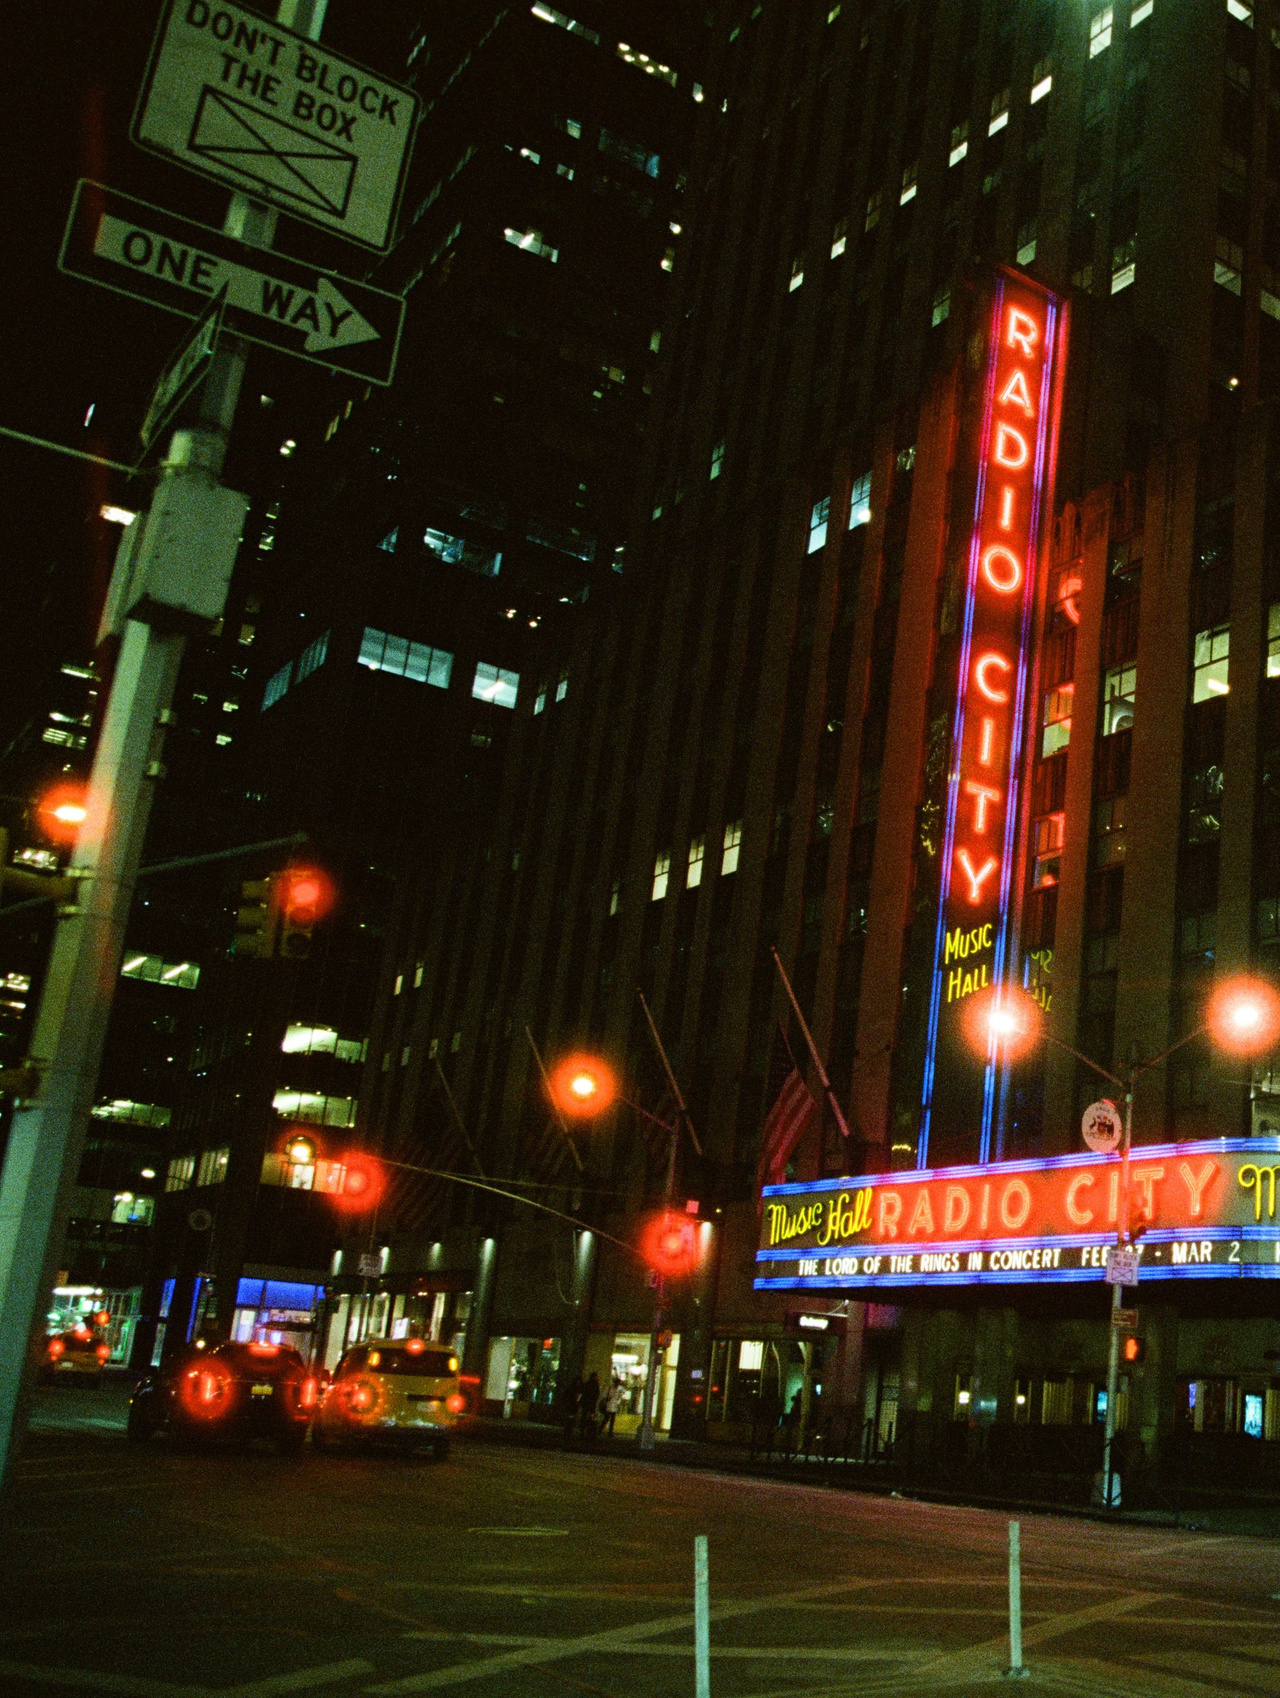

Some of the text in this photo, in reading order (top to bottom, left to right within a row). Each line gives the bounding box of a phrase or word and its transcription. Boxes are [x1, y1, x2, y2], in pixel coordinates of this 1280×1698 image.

[185, 2, 401, 127] DON'T BLOCK
[219, 54, 358, 142] THE BOX
[122, 230, 353, 338] ONE WAY
[957, 305, 1038, 904] RADIO CITY
[768, 1202, 823, 1245] Music
[817, 1187, 873, 1246] Hall
[879, 1179, 1031, 1237] RADIO
[1066, 1161, 1217, 1225] CITY
[798, 1258, 818, 1276] THE
[825, 1257, 858, 1275] LORD
[863, 1256, 883, 1274] OF
[891, 1254, 914, 1273] THE
[920, 1252, 960, 1272] RINGS
[968, 1252, 983, 1271] IN
[989, 1248, 1062, 1271] CONCERT
[1172, 1241, 1213, 1264] MAR
[1228, 1242, 1241, 1263] 2
